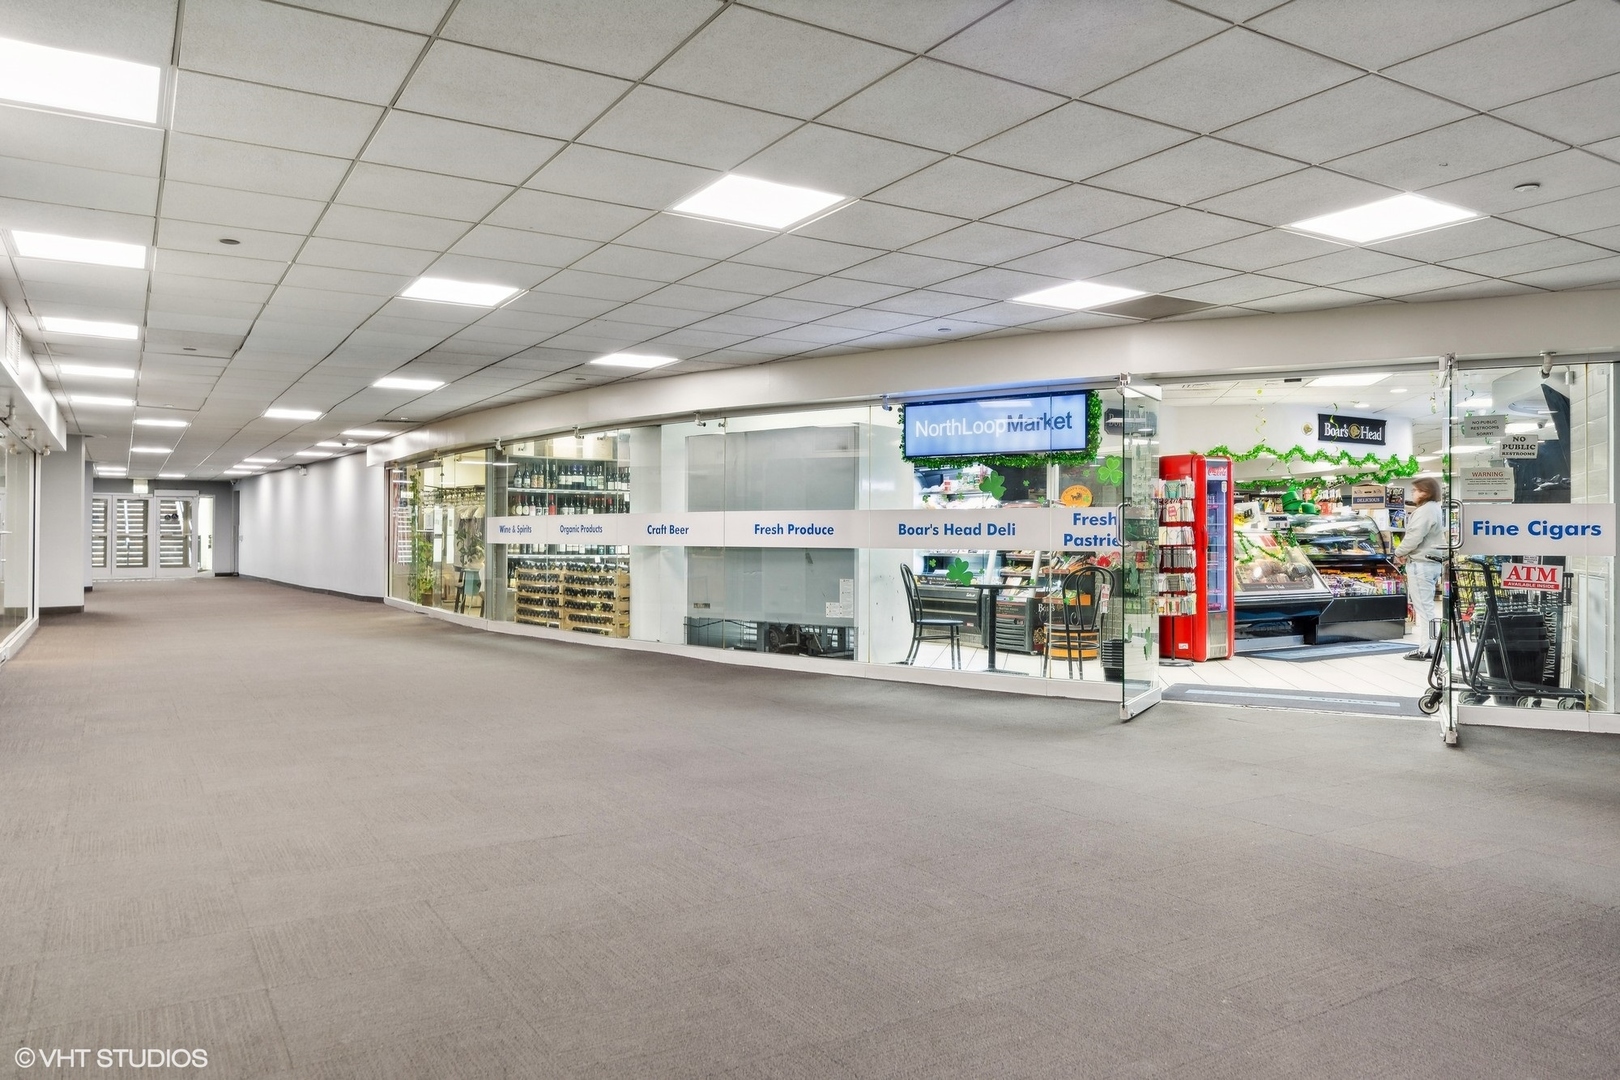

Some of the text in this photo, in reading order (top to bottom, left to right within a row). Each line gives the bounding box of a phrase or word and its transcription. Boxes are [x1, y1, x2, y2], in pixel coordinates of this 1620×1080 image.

[915, 411, 1072, 438] NorthLoopMarket
[1324, 422, 1382, 440] Boar's Head
[1073, 512, 1117, 526] Fresh
[499, 525, 532, 536] Wine & Spirits
[559, 524, 603, 536] Organic Products
[647, 524, 689, 535] Craft Beer
[754, 523, 835, 536] Fresh Produce
[898, 523, 1016, 536] Boar's Head Deli
[1472, 520, 1602, 540] Fine Cigars
[1063, 533, 1119, 547] Pastrie
[1506, 565, 1557, 583] ATM
